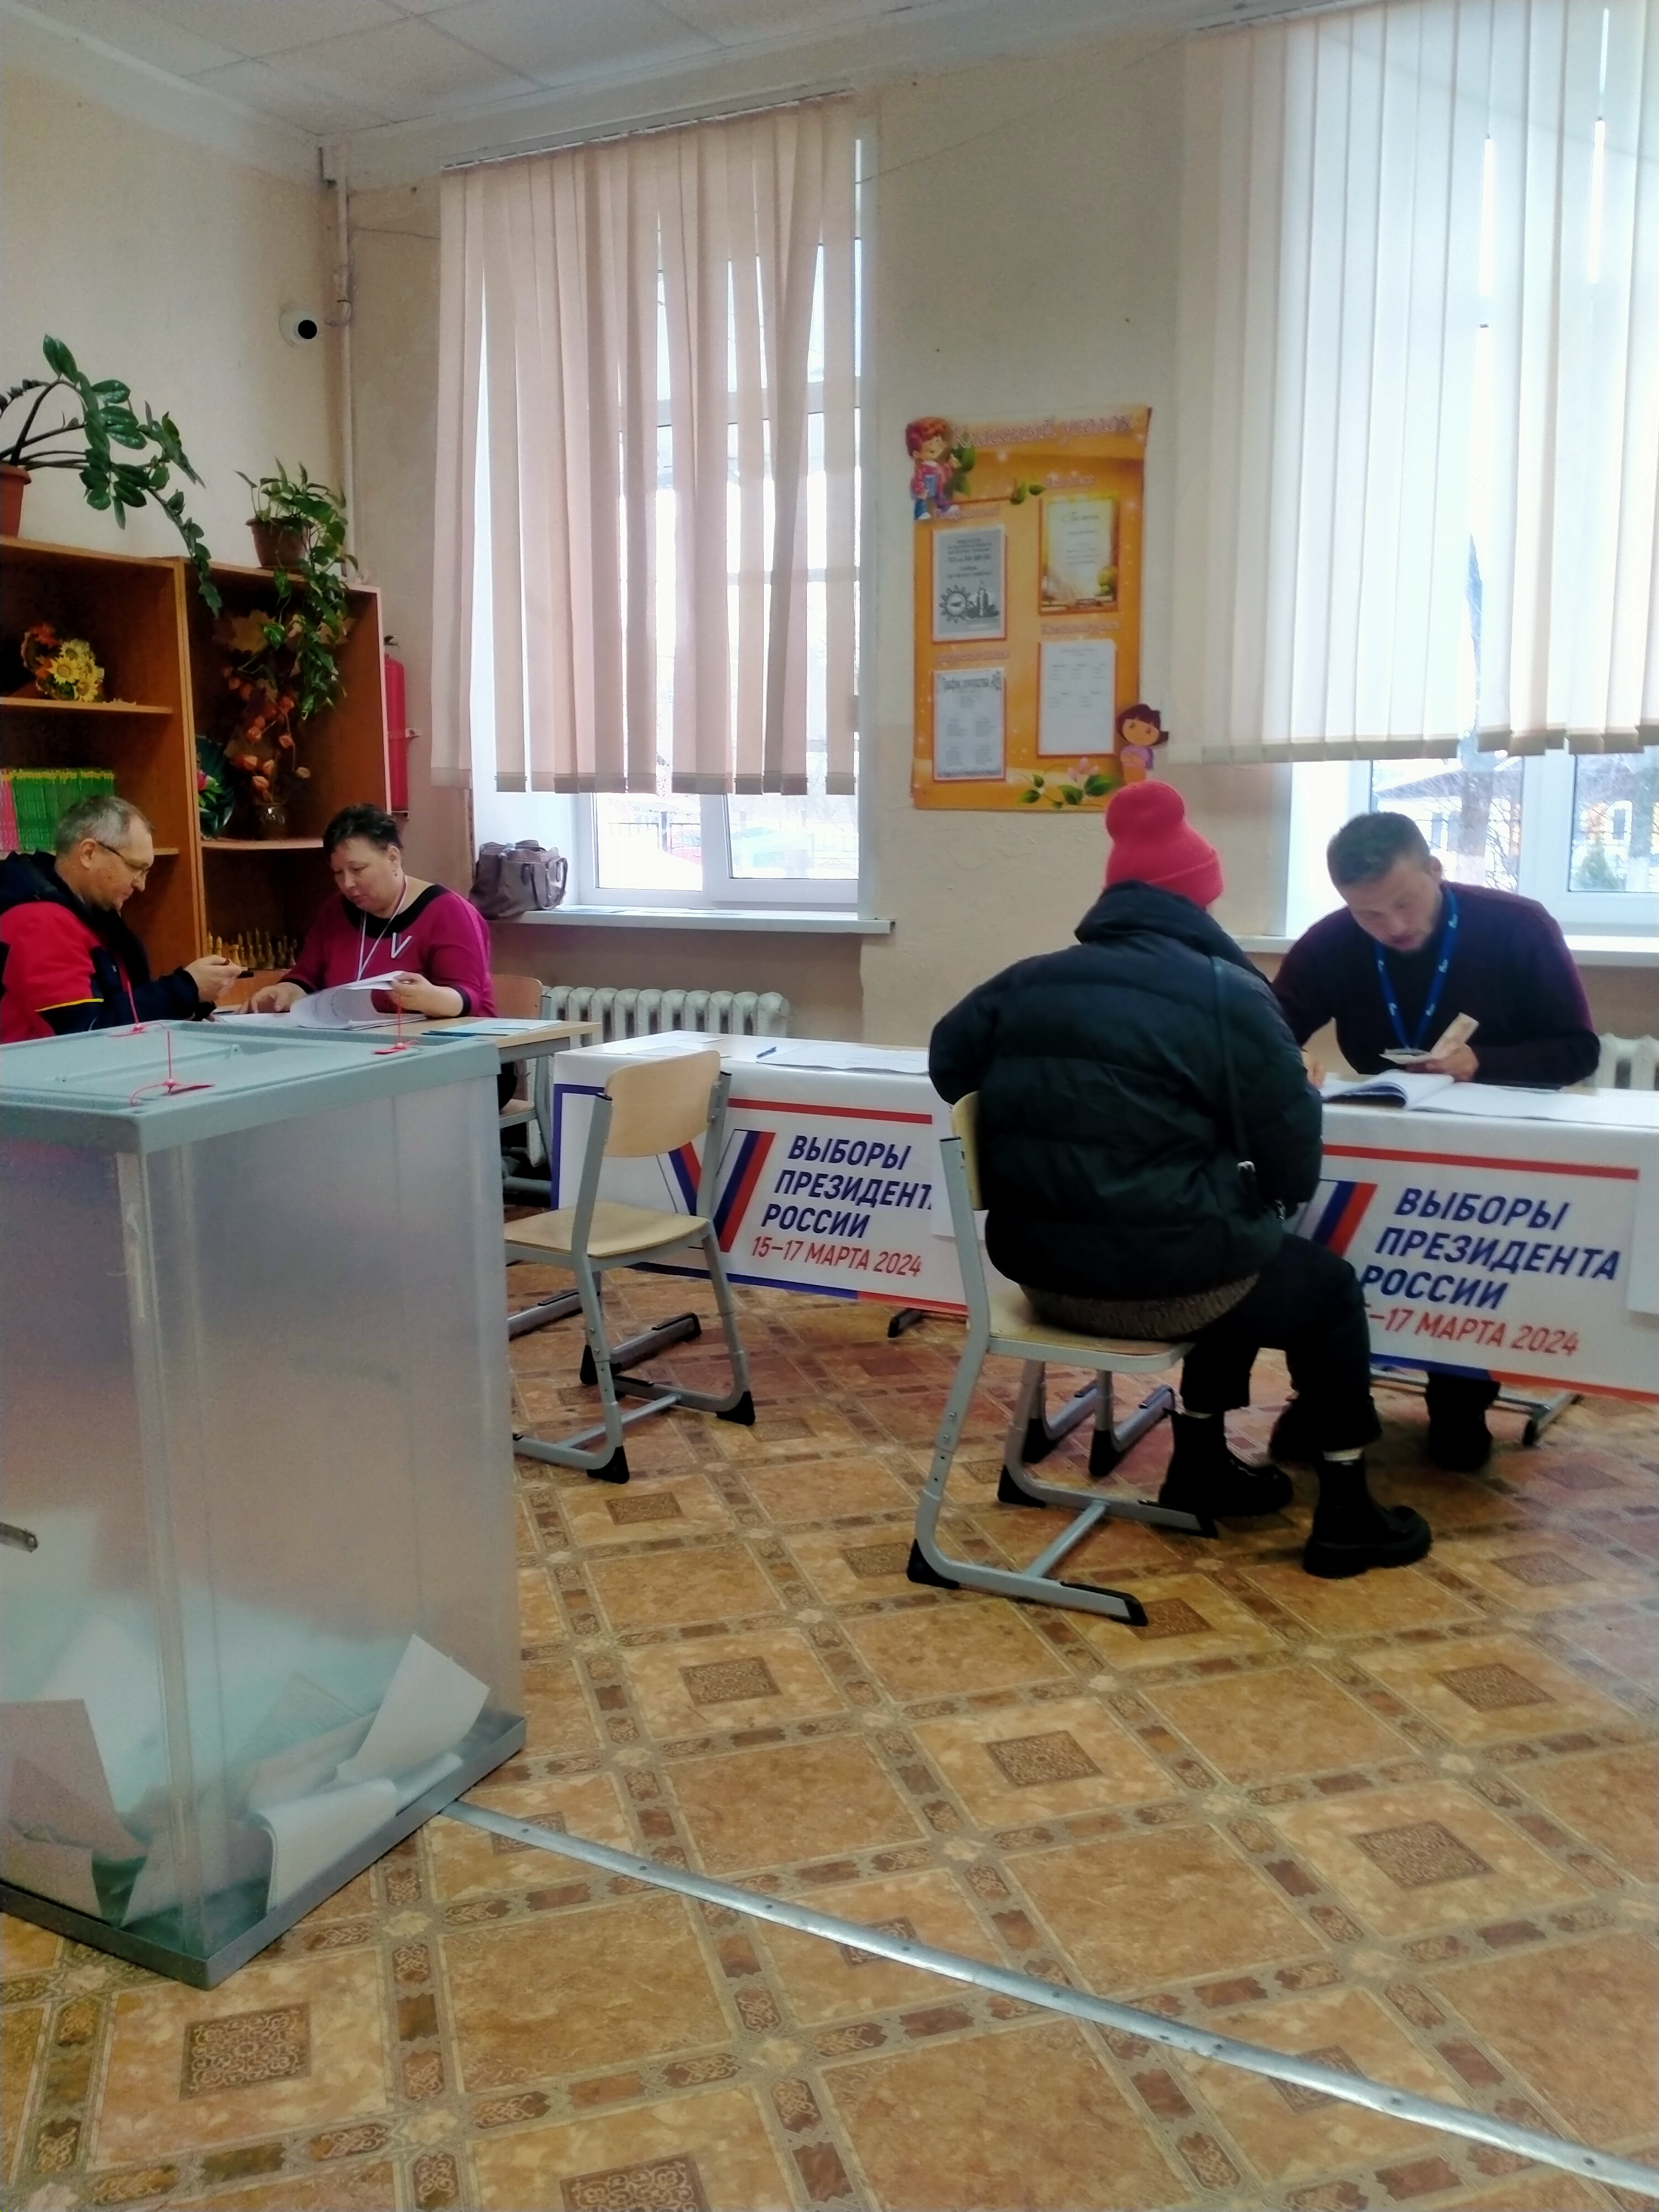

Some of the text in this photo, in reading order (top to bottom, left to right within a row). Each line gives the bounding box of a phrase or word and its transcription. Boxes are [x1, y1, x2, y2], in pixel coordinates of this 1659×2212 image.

[787, 1135, 912, 1170] ВЫБОРЫ
[773, 1169, 932, 1210] ПРЕЗИДЕНТ
[1394, 1187, 1570, 1230] ВЫБОРЫ
[760, 1203, 870, 1239] РОССИИ
[805, 1243, 870, 1271] МАРТА
[873, 1251, 922, 1277] 2024
[1374, 1226, 1620, 1280] ПРЕЗИДЕНТА
[1361, 1264, 1509, 1310] РОССИИ
[1413, 1312, 1507, 1349] МАРТА
[1511, 1325, 1579, 1357] 2024
